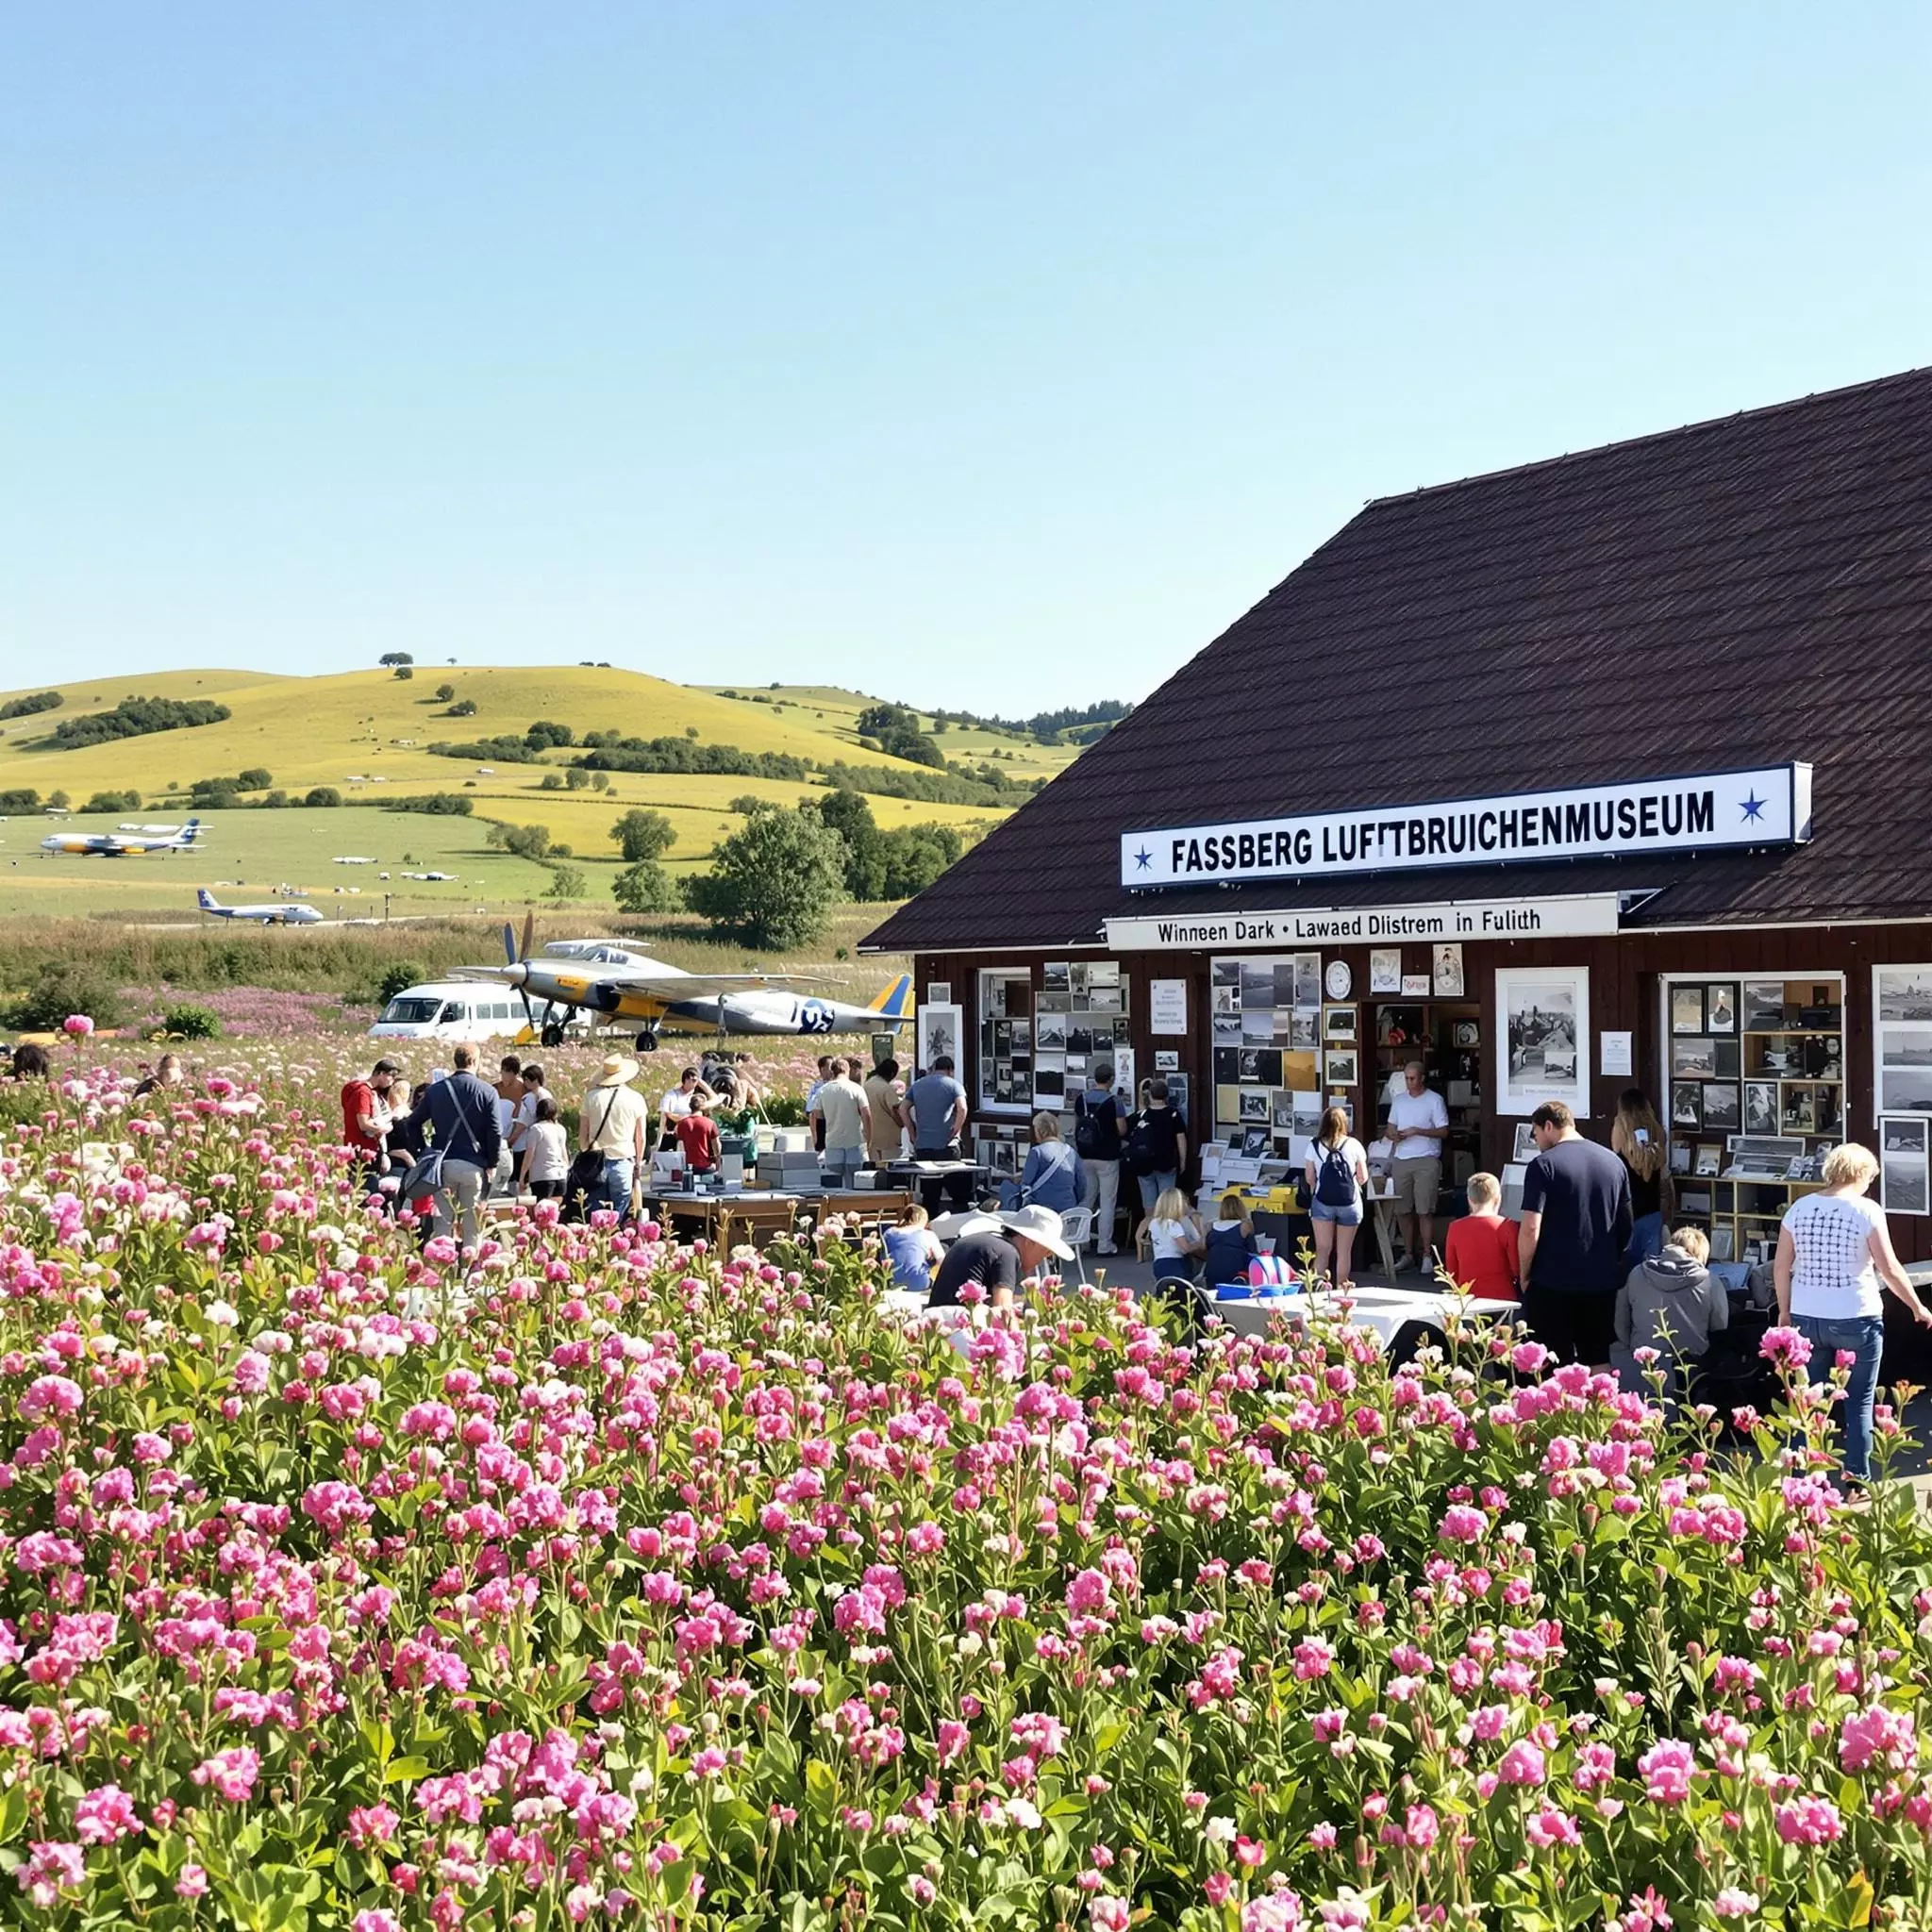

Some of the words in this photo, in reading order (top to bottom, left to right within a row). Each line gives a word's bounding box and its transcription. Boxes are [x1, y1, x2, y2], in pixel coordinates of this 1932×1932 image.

[1172, 828, 1312, 874] FASSBERG
[1235, 920, 1274, 941] Dark
[1457, 911, 1473, 932] in
